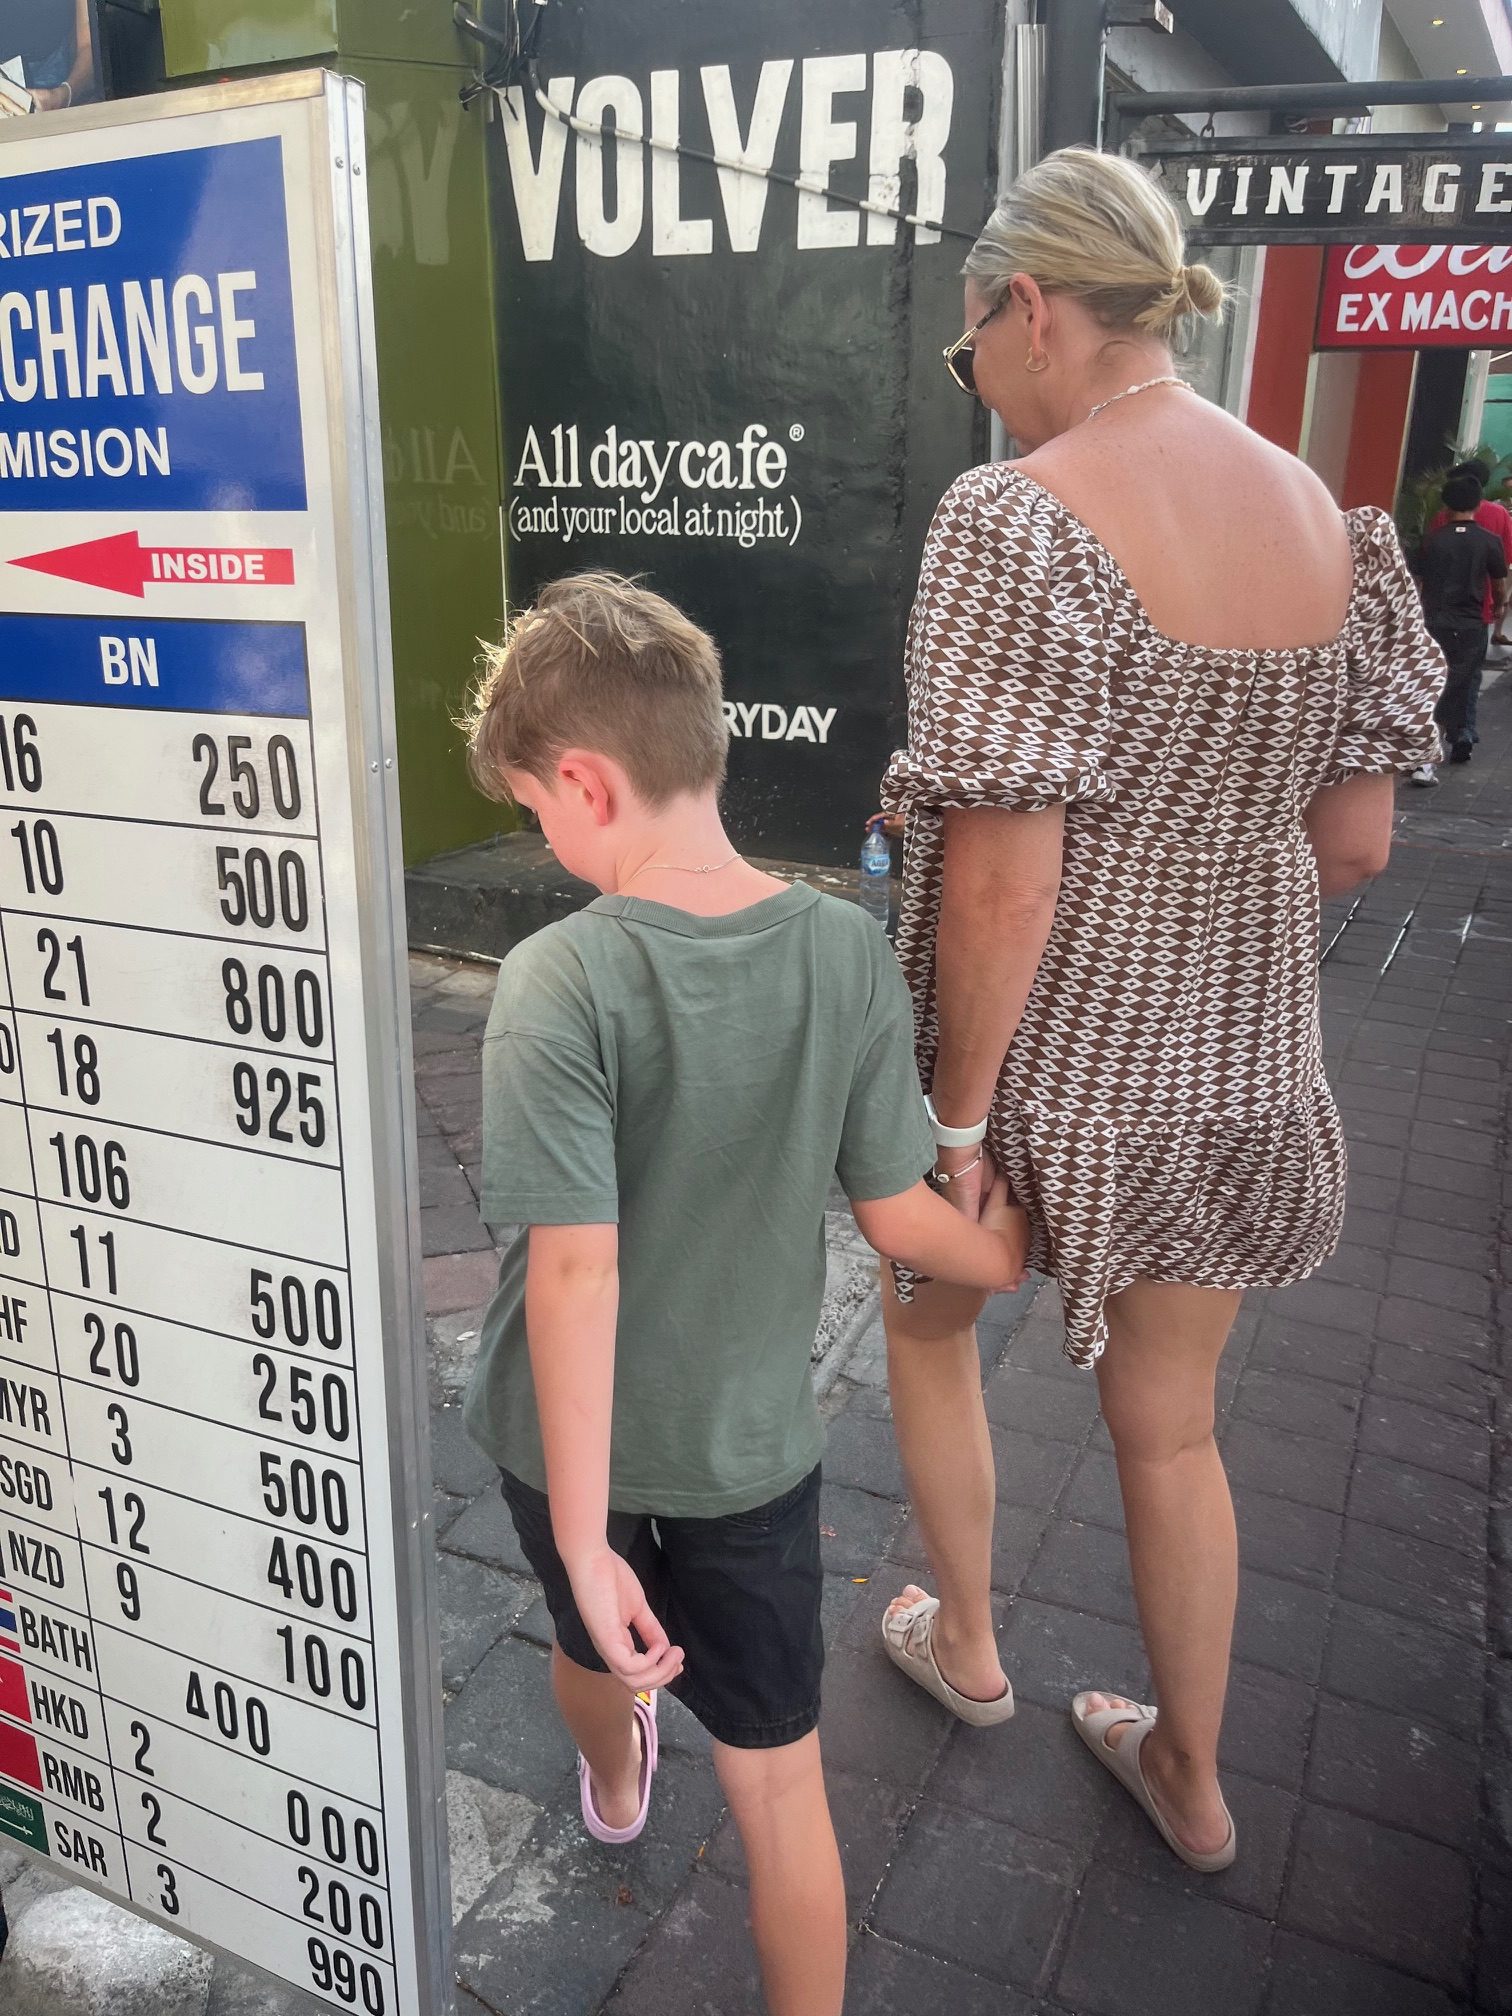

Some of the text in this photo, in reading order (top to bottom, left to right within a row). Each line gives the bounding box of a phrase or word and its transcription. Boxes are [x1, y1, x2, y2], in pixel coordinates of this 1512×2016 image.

[500, 48, 955, 262] VOLVER
[1186, 163, 1512, 216] VINTAGE
[0, 270, 265, 403] CHANGE
[1336, 289, 1512, 334] EX MACH
[0, 427, 171, 479] MISION
[513, 423, 582, 488] All
[590, 424, 680, 504] day
[151, 552, 266, 581] INSIDE
[509, 495, 802, 548] (and your local at night)
[99, 636, 160, 687] BN
[0, 713, 301, 820] 16 250
[10, 819, 308, 933] 10 500
[37, 928, 324, 1048] 21 800
[46, 1027, 101, 1106] 18
[233, 1061, 326, 1148] 925
[49, 1131, 130, 1210] 106
[0, 1208, 343, 1351] D 11 500
[83, 1312, 140, 1387] 20
[252, 1353, 350, 1442] 250
[107, 1403, 133, 1466] 3
[259, 1451, 349, 1536] 500
[0, 1454, 358, 1622] SGD 12 400
[7, 1529, 366, 1711] NZD 9 100
[18, 1605, 93, 1673] BATH
[30, 1680, 380, 1877] HKD 2 000
[42, 1751, 105, 1813] RMB
[141, 1791, 167, 1848] 2
[297, 1865, 384, 1950] 200
[54, 1820, 385, 2016] SAR 3 990
